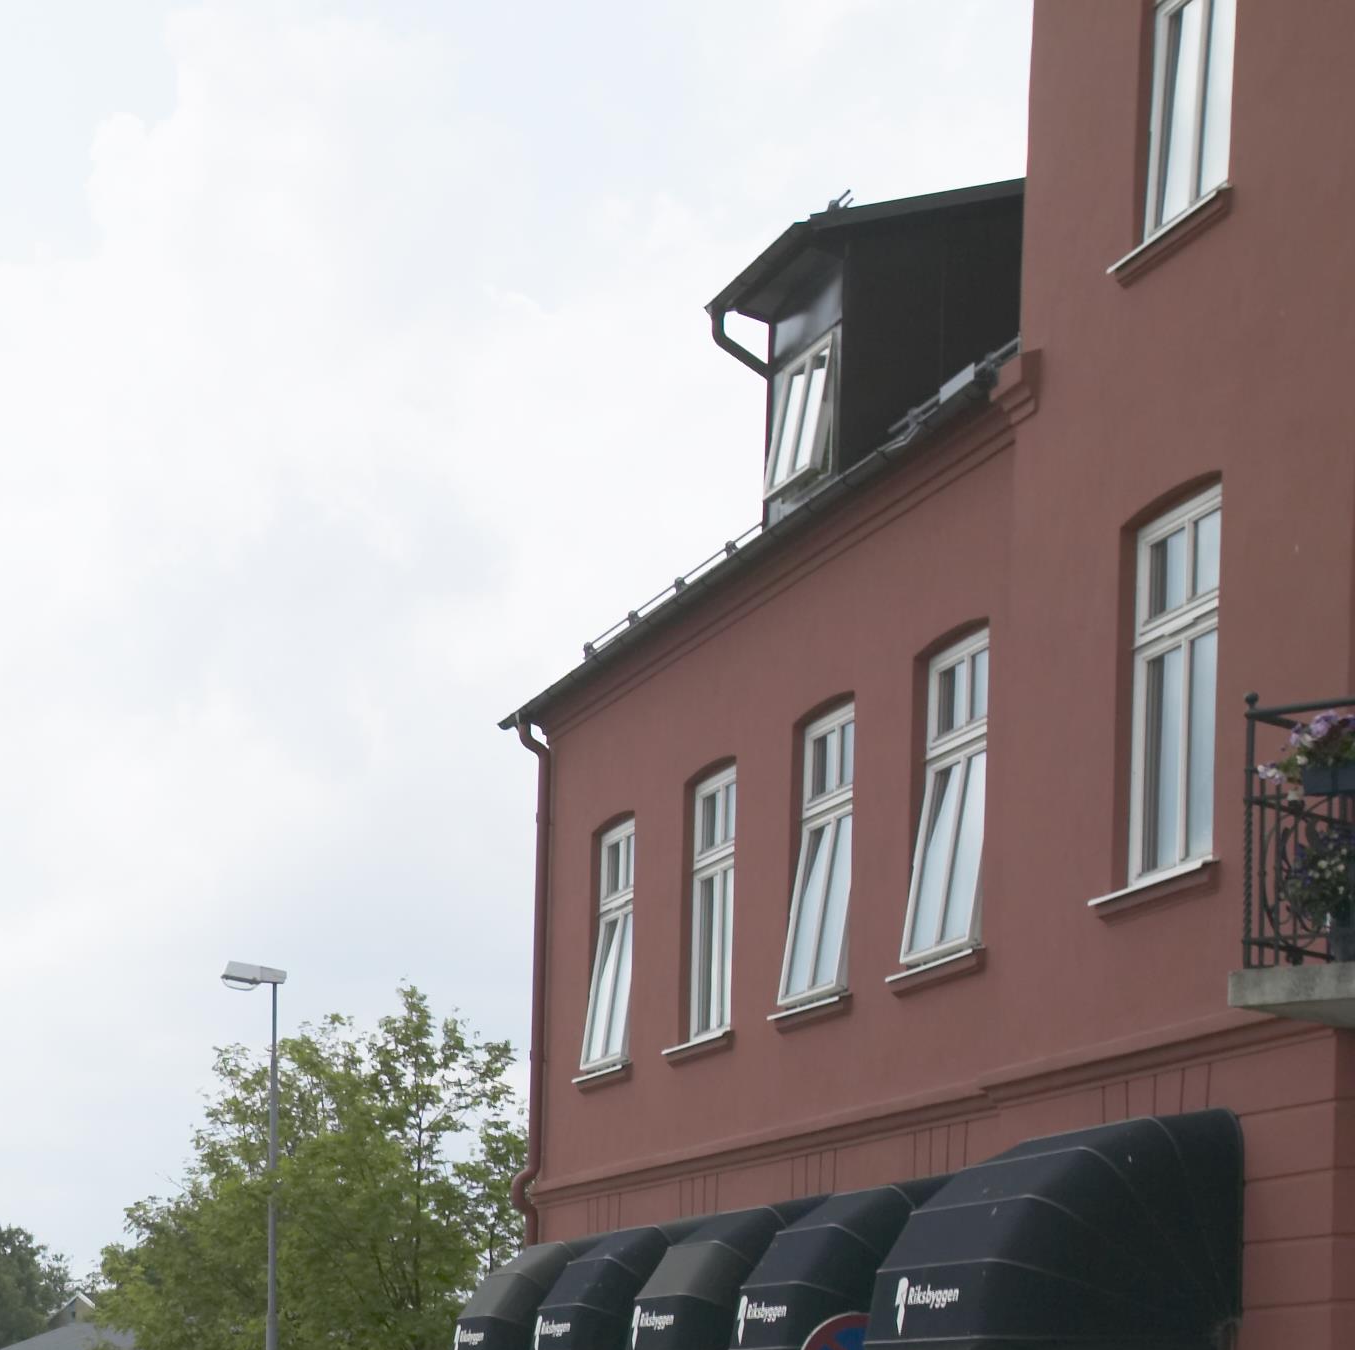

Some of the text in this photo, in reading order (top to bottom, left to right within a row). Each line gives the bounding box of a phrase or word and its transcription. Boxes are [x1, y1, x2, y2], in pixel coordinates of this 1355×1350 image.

[908, 1284, 960, 1309] Riksbyggen
[640, 1310, 675, 1330] Riksbyggen
[746, 1302, 788, 1323] Riksbyggen
[460, 1329, 485, 1346] Riksbyggen
[541, 1320, 571, 1338] Riksbyggen
